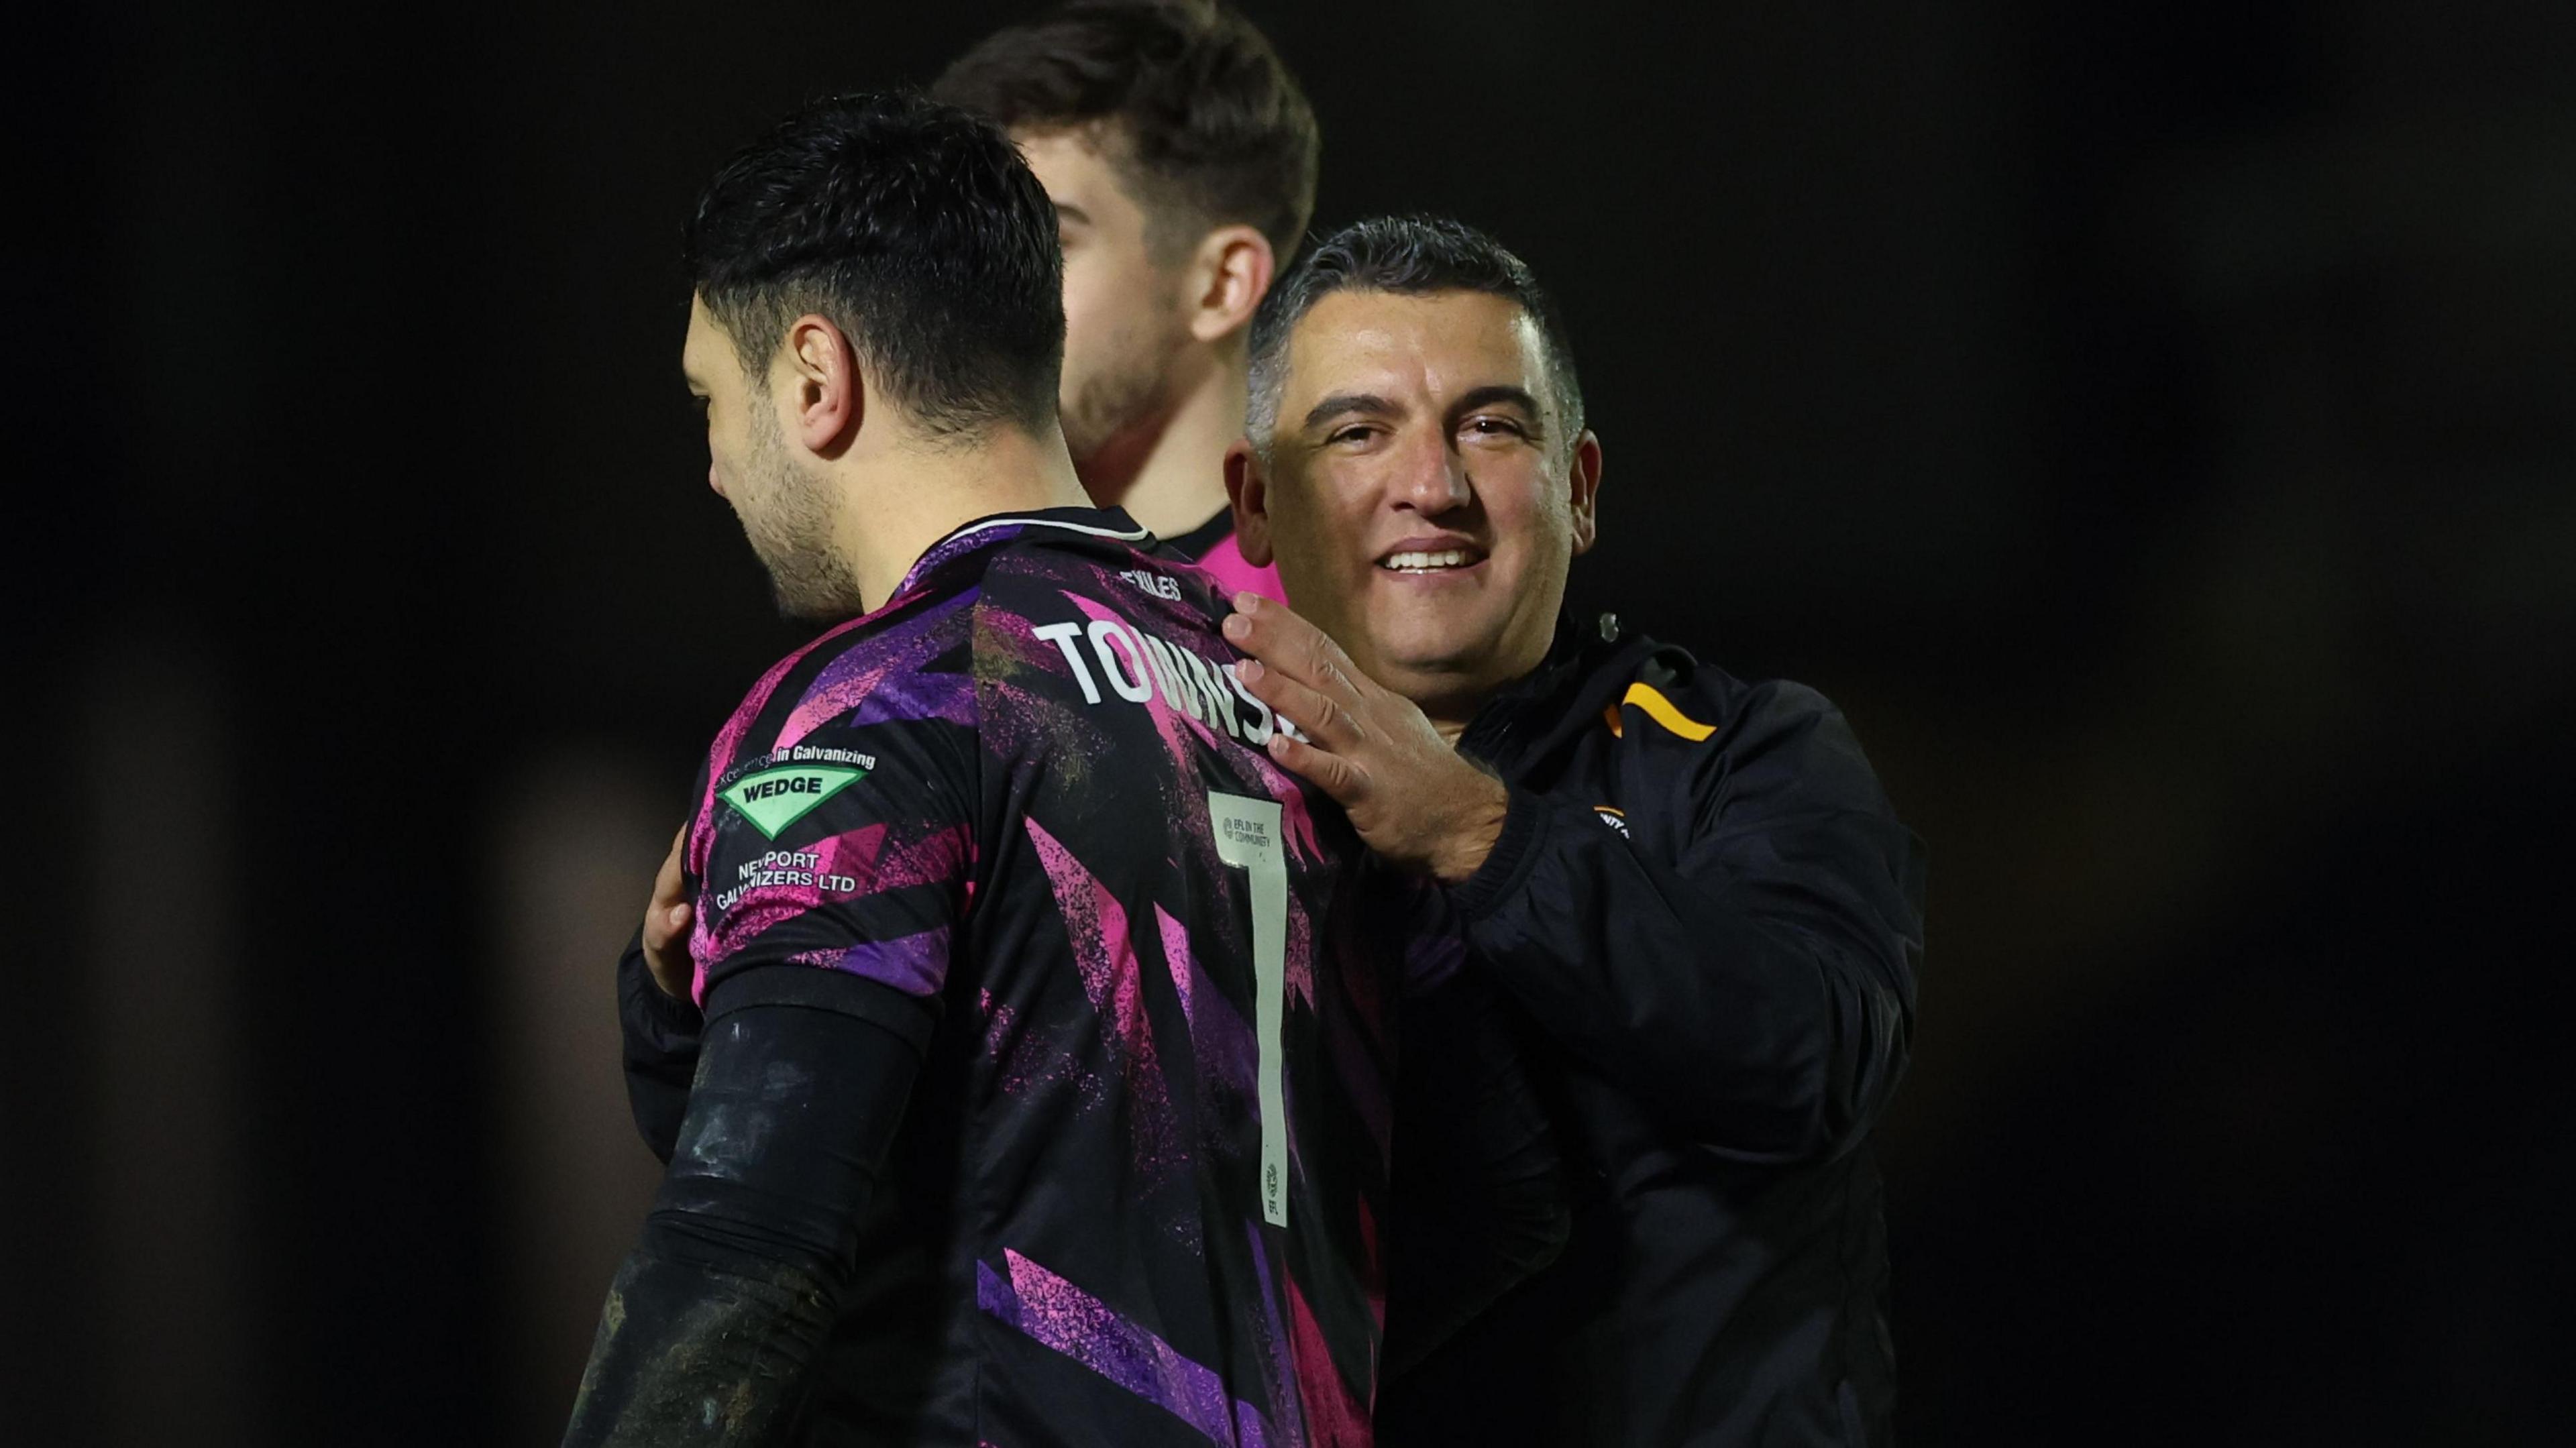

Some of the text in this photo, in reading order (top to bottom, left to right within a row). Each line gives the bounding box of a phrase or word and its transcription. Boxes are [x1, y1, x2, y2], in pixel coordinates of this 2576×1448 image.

[776, 747, 790, 762] in
[793, 746, 875, 770] Galvanizing
[743, 777, 823, 804] WEDGE
[1253, 822, 1264, 835] THE
[818, 875, 856, 893] LTD
